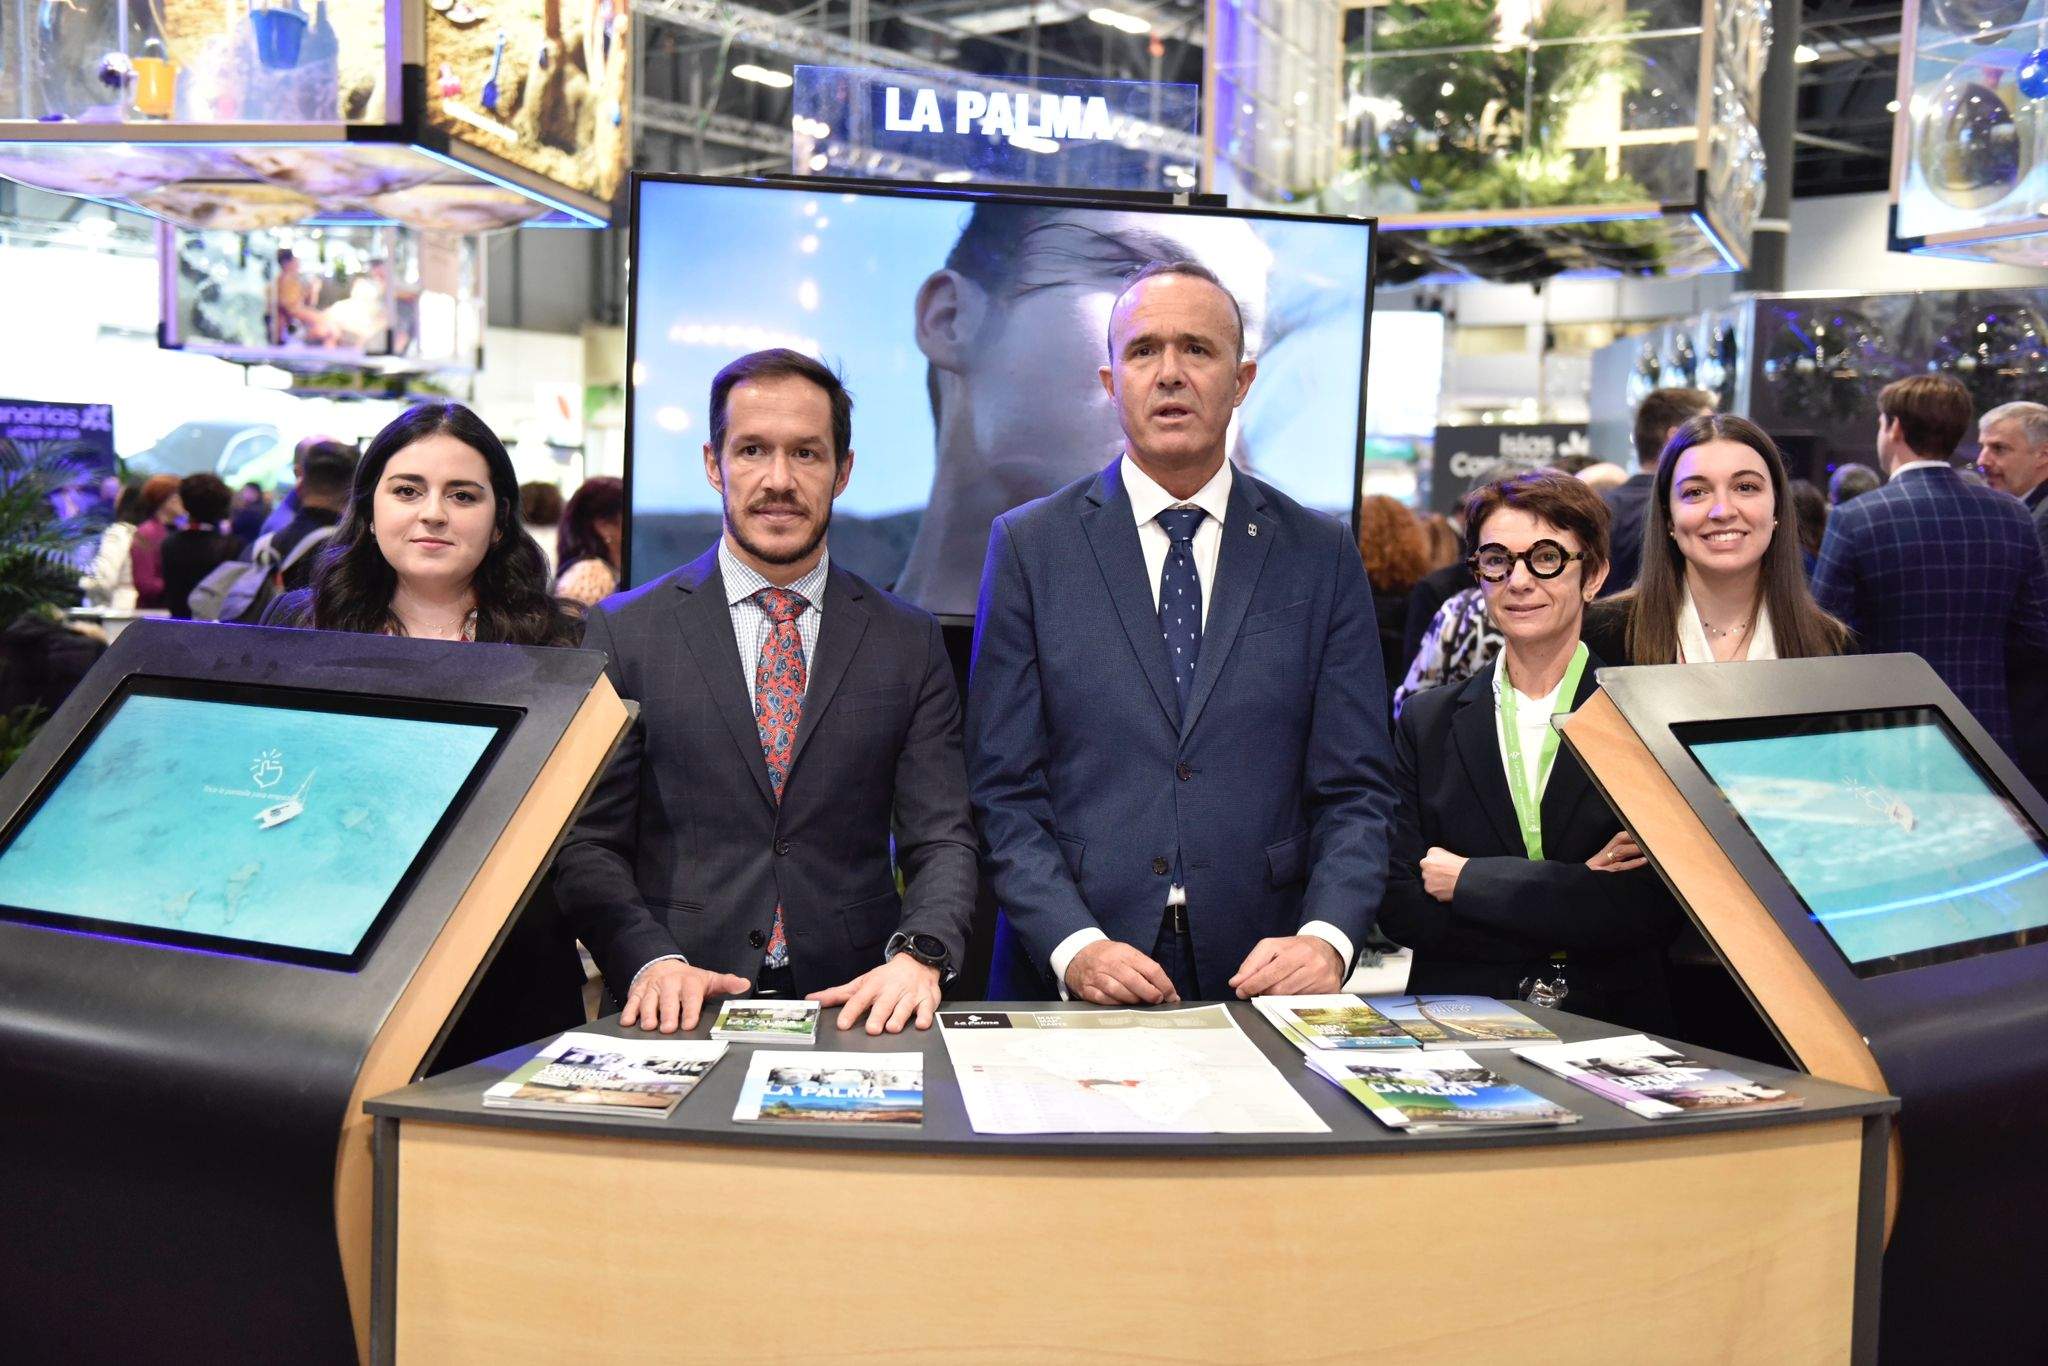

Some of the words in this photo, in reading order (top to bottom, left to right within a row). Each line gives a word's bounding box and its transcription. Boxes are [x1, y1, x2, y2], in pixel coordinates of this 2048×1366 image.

[885, 87, 944, 132] LA
[956, 90, 1114, 141] PALMA
[0, 404, 79, 427] narias
[759, 1085, 794, 1096] LA
[800, 1086, 886, 1099] PALMA
[1368, 1083, 1402, 1093] LA
[1398, 1083, 1478, 1096] PALMA
